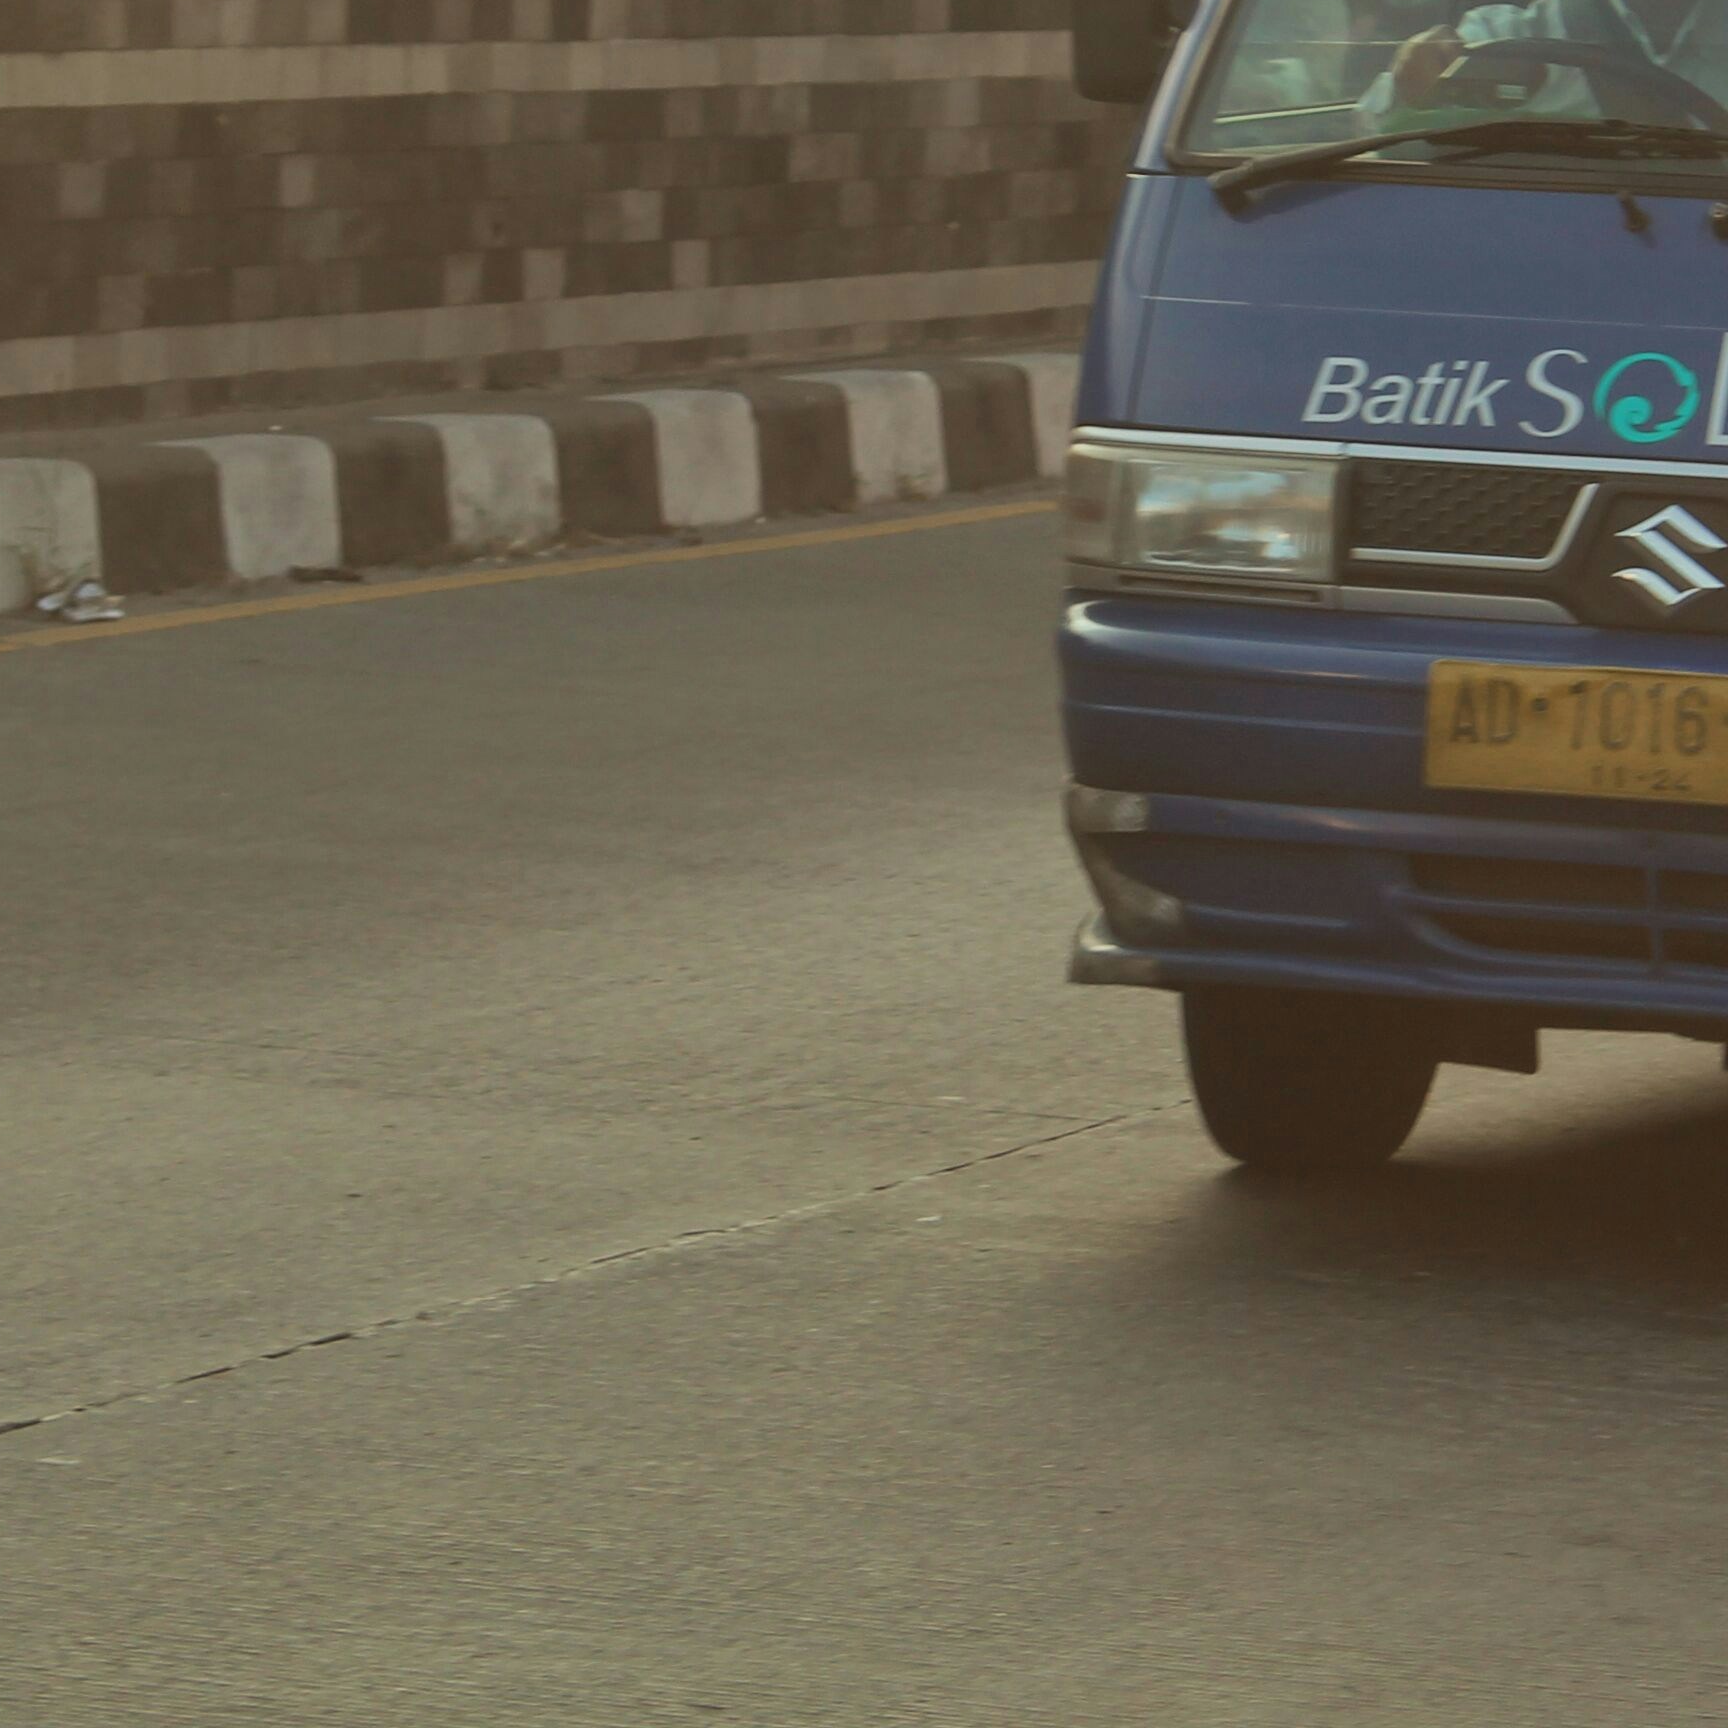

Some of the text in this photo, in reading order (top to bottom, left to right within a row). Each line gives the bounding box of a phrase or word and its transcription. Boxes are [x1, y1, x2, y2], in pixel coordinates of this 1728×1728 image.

[1301, 356, 1510, 427] Batik
[1449, 676, 1522, 745] AD
[1568, 678, 1710, 756] 1016
